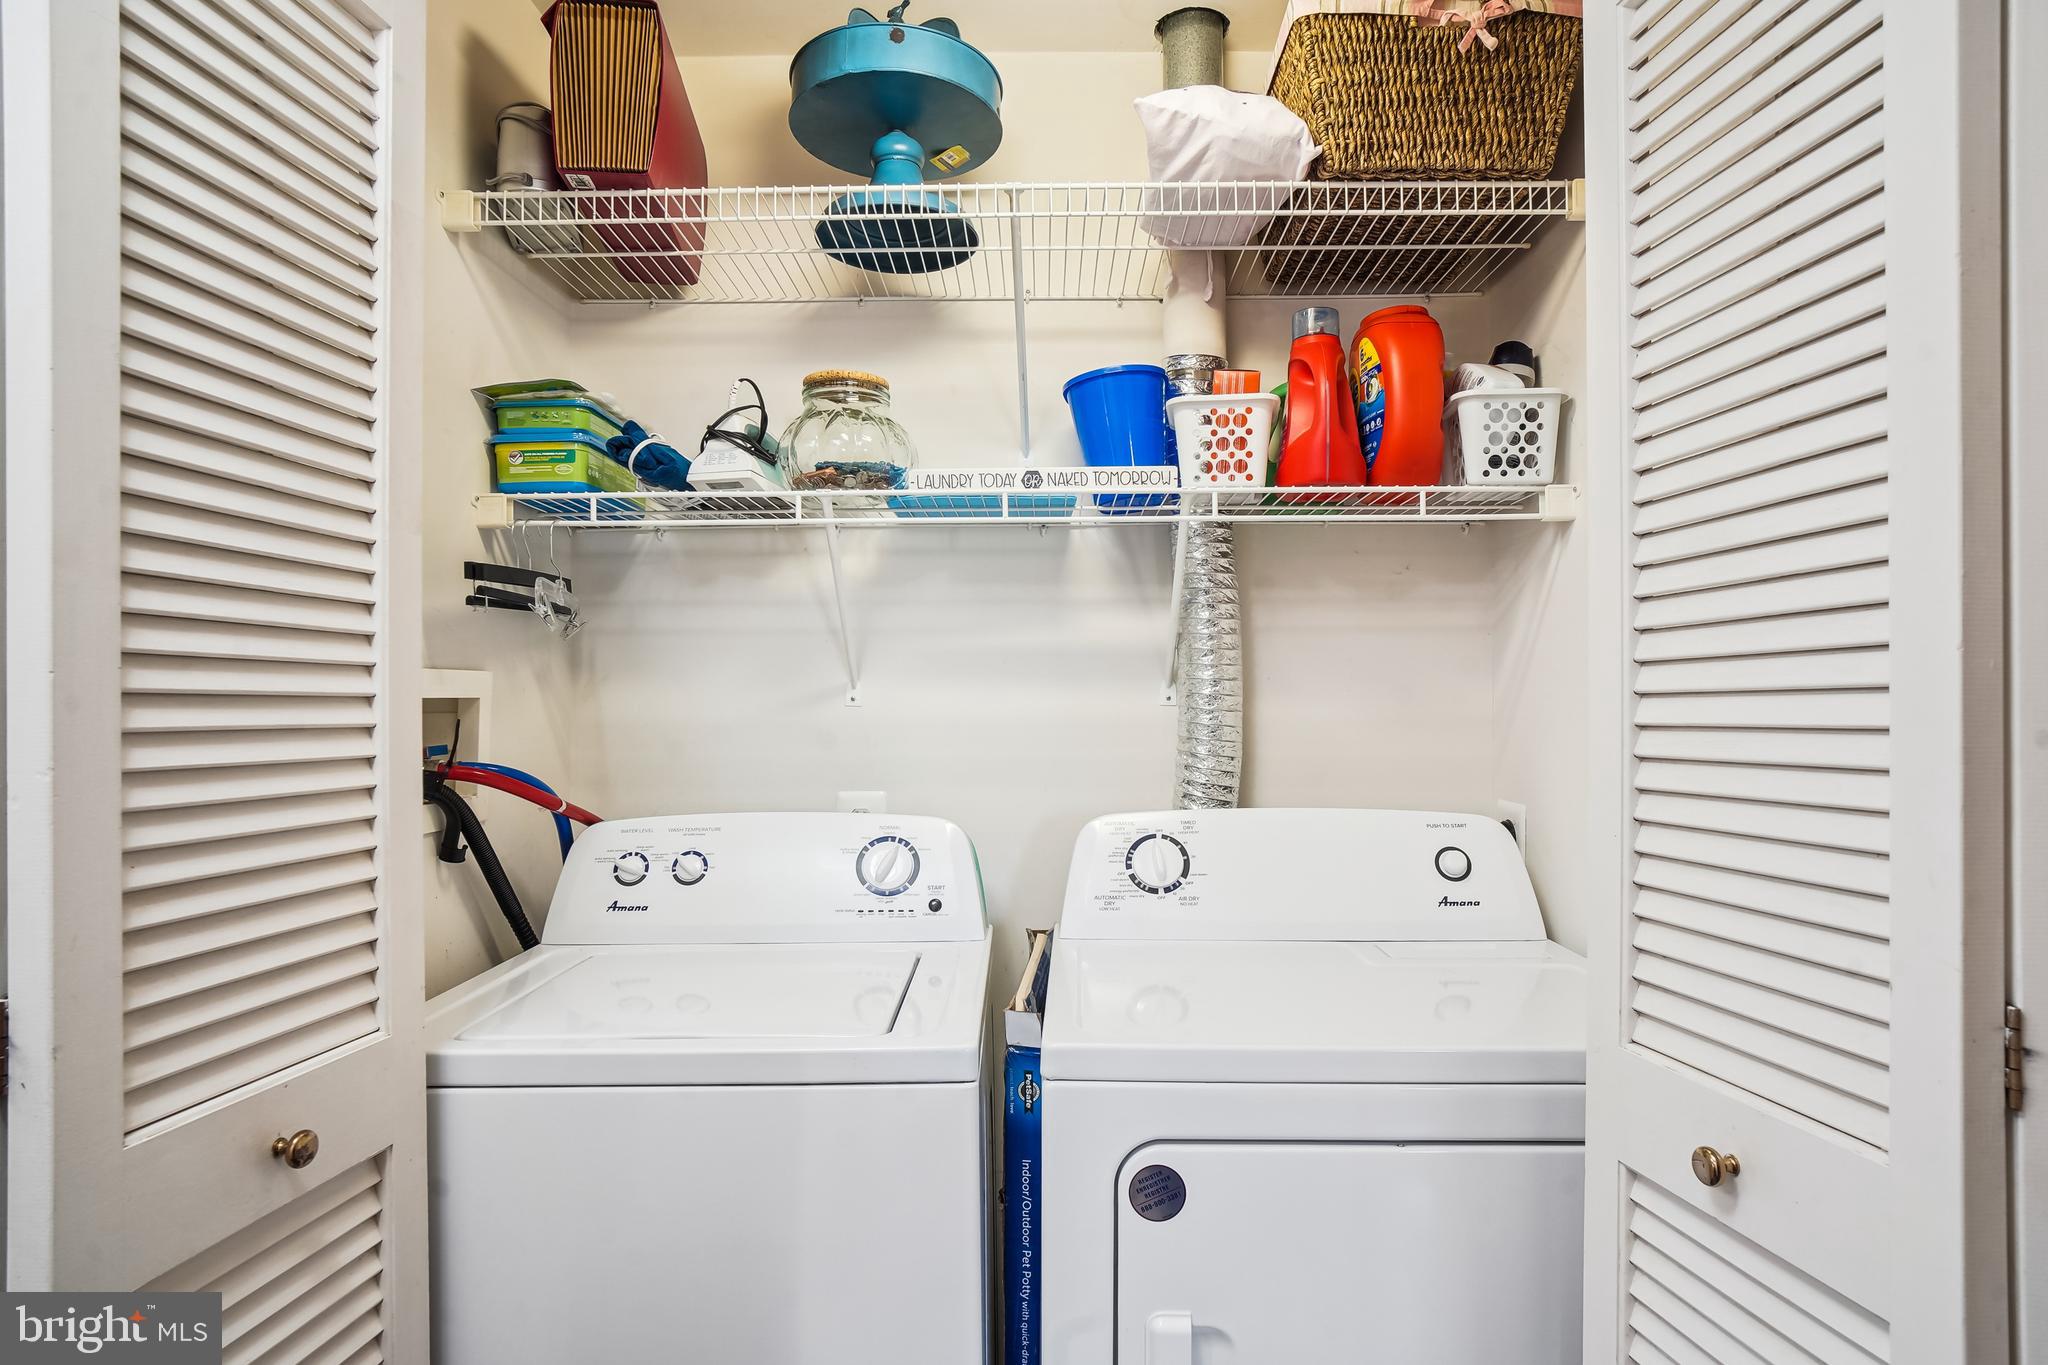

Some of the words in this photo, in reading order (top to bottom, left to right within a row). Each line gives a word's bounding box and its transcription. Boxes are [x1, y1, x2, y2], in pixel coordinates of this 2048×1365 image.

[917, 471, 974, 489] LAUNDRY
[978, 472, 1017, 488] TODAY
[1047, 471, 1089, 487] NAKED
[1093, 470, 1171, 486] TOMORROW
[606, 900, 648, 912] Amana
[1438, 896, 1481, 907] Amana
[1025, 1073, 1033, 1109] PetSafe
[1022, 1159, 1032, 1247] Indoor/Outdoor
[1022, 1250, 1032, 1268] Pet
[1020, 1270, 1032, 1300] Potty
[1022, 1301, 1030, 1321] with
[1020, 1322, 1030, 1365] quick-dra
